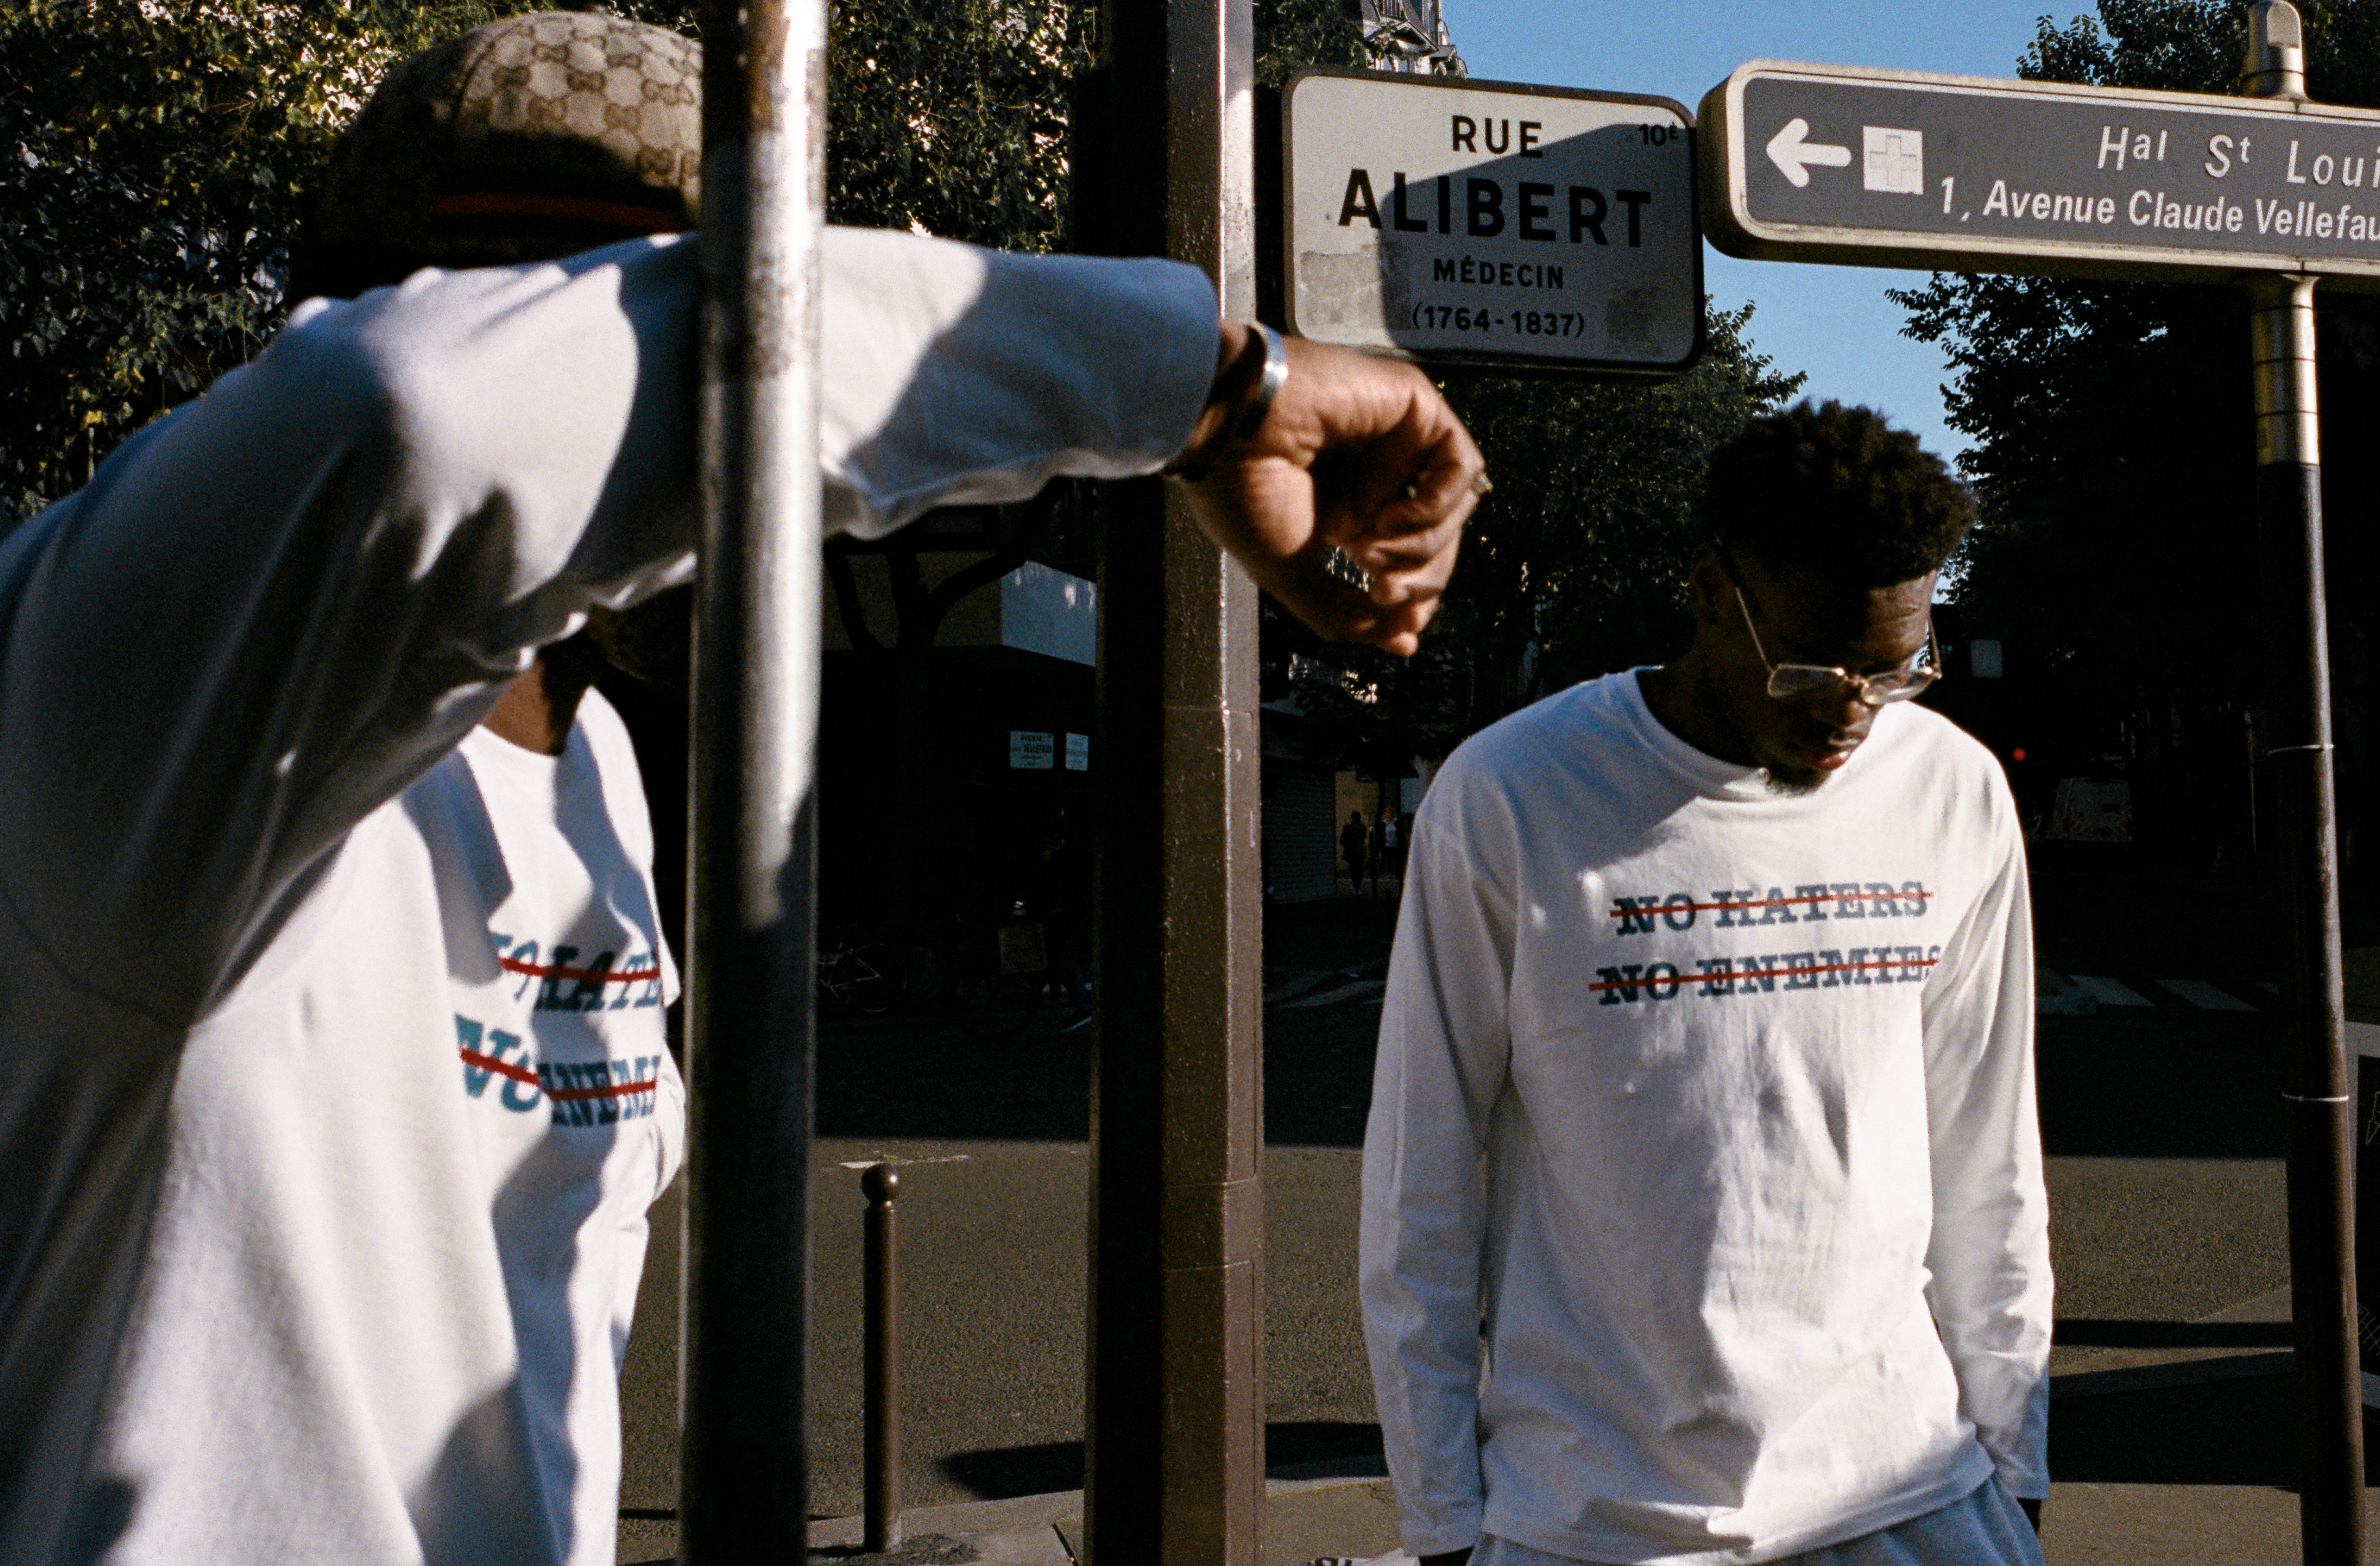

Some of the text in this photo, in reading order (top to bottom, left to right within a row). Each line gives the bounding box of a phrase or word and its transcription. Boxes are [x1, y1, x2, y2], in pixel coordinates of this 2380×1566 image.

[1452, 115, 1543, 158] RUE
[2097, 125, 2168, 171] Hal
[2204, 134, 2252, 178] St
[1338, 168, 1652, 248] ALIBERT
[1982, 180, 2116, 224] Avenue
[2129, 189, 2244, 232] Claude
[1433, 256, 1564, 289] MÉDECIN
[1412, 301, 1585, 338] (1764-1837)
[1613, 880, 1928, 936] NO HATERS
[1596, 961, 1680, 1007] NO
